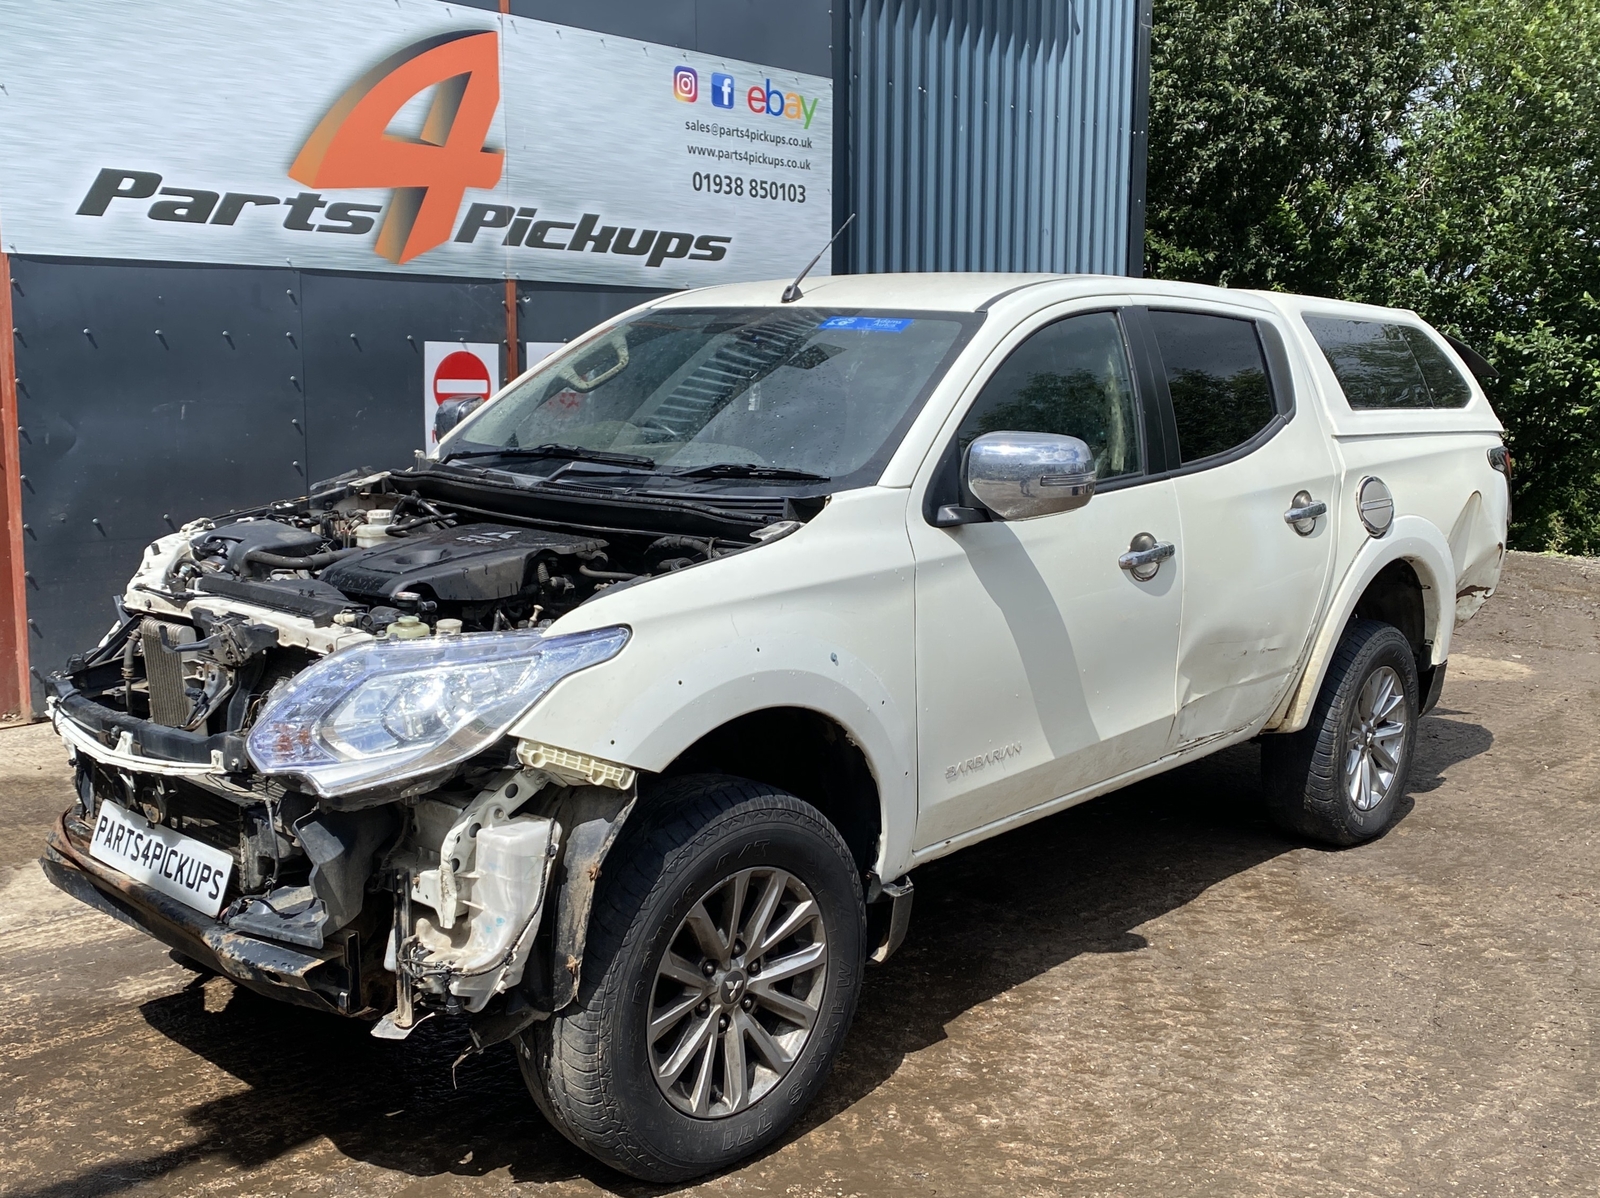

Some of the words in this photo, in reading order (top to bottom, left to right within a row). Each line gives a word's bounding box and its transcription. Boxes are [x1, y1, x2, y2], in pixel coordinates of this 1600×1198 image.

[747, 78, 819, 130] ebay
[75, 167, 383, 235] Parts
[287, 29, 505, 266] 4
[454, 202, 732, 267] Pickups
[685, 119, 813, 149] sales@parts4pickups.co.uk
[687, 144, 811, 171] www.parts4pickups.co.uk
[692, 171, 744, 197] 01938
[749, 178, 806, 204] 850103
[944, 741, 1023, 781] BARBARIAN
[95, 815, 224, 900] PARTS4PICKUPS
